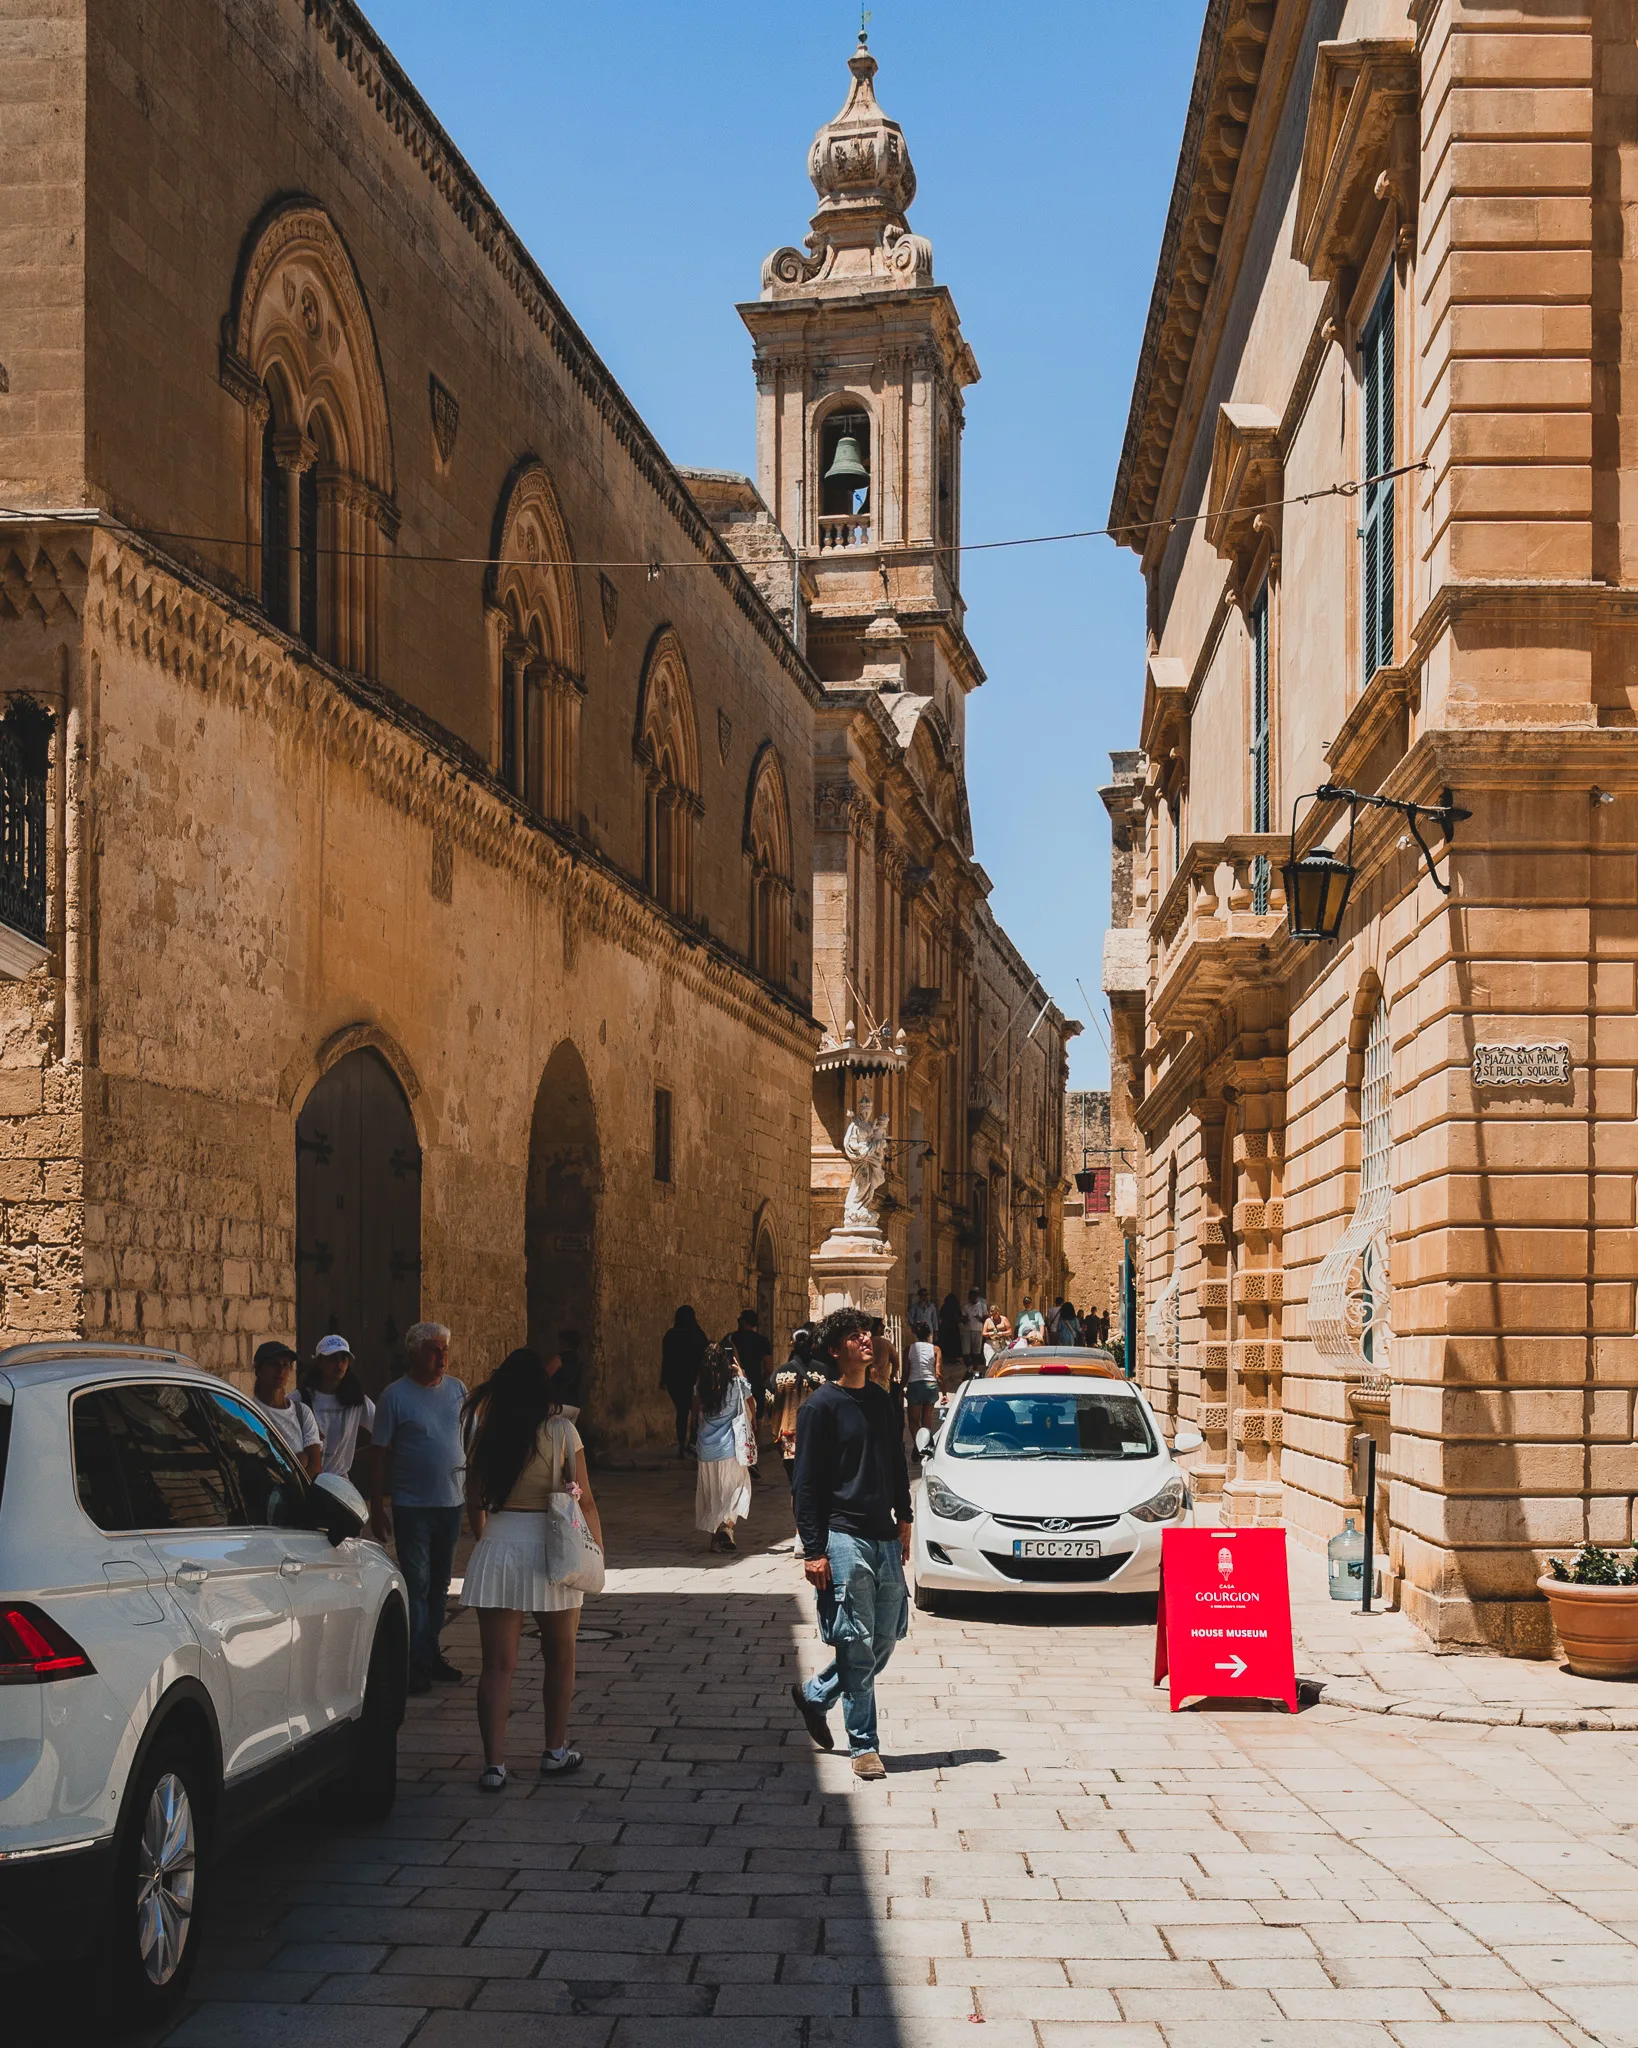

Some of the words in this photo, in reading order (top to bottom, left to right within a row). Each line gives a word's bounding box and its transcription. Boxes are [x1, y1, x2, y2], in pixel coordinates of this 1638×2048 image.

[1517, 1054, 1534, 1065] SAN
[1537, 1054, 1559, 1064] PAWL
[1496, 1066, 1523, 1077] PAUL'S
[1527, 1065, 1560, 1077] SQUARE
[1195, 1592, 1260, 1602] GOURGION
[1191, 1629, 1224, 1637] HOUSE
[1226, 1630, 1268, 1638] MUSEUM
